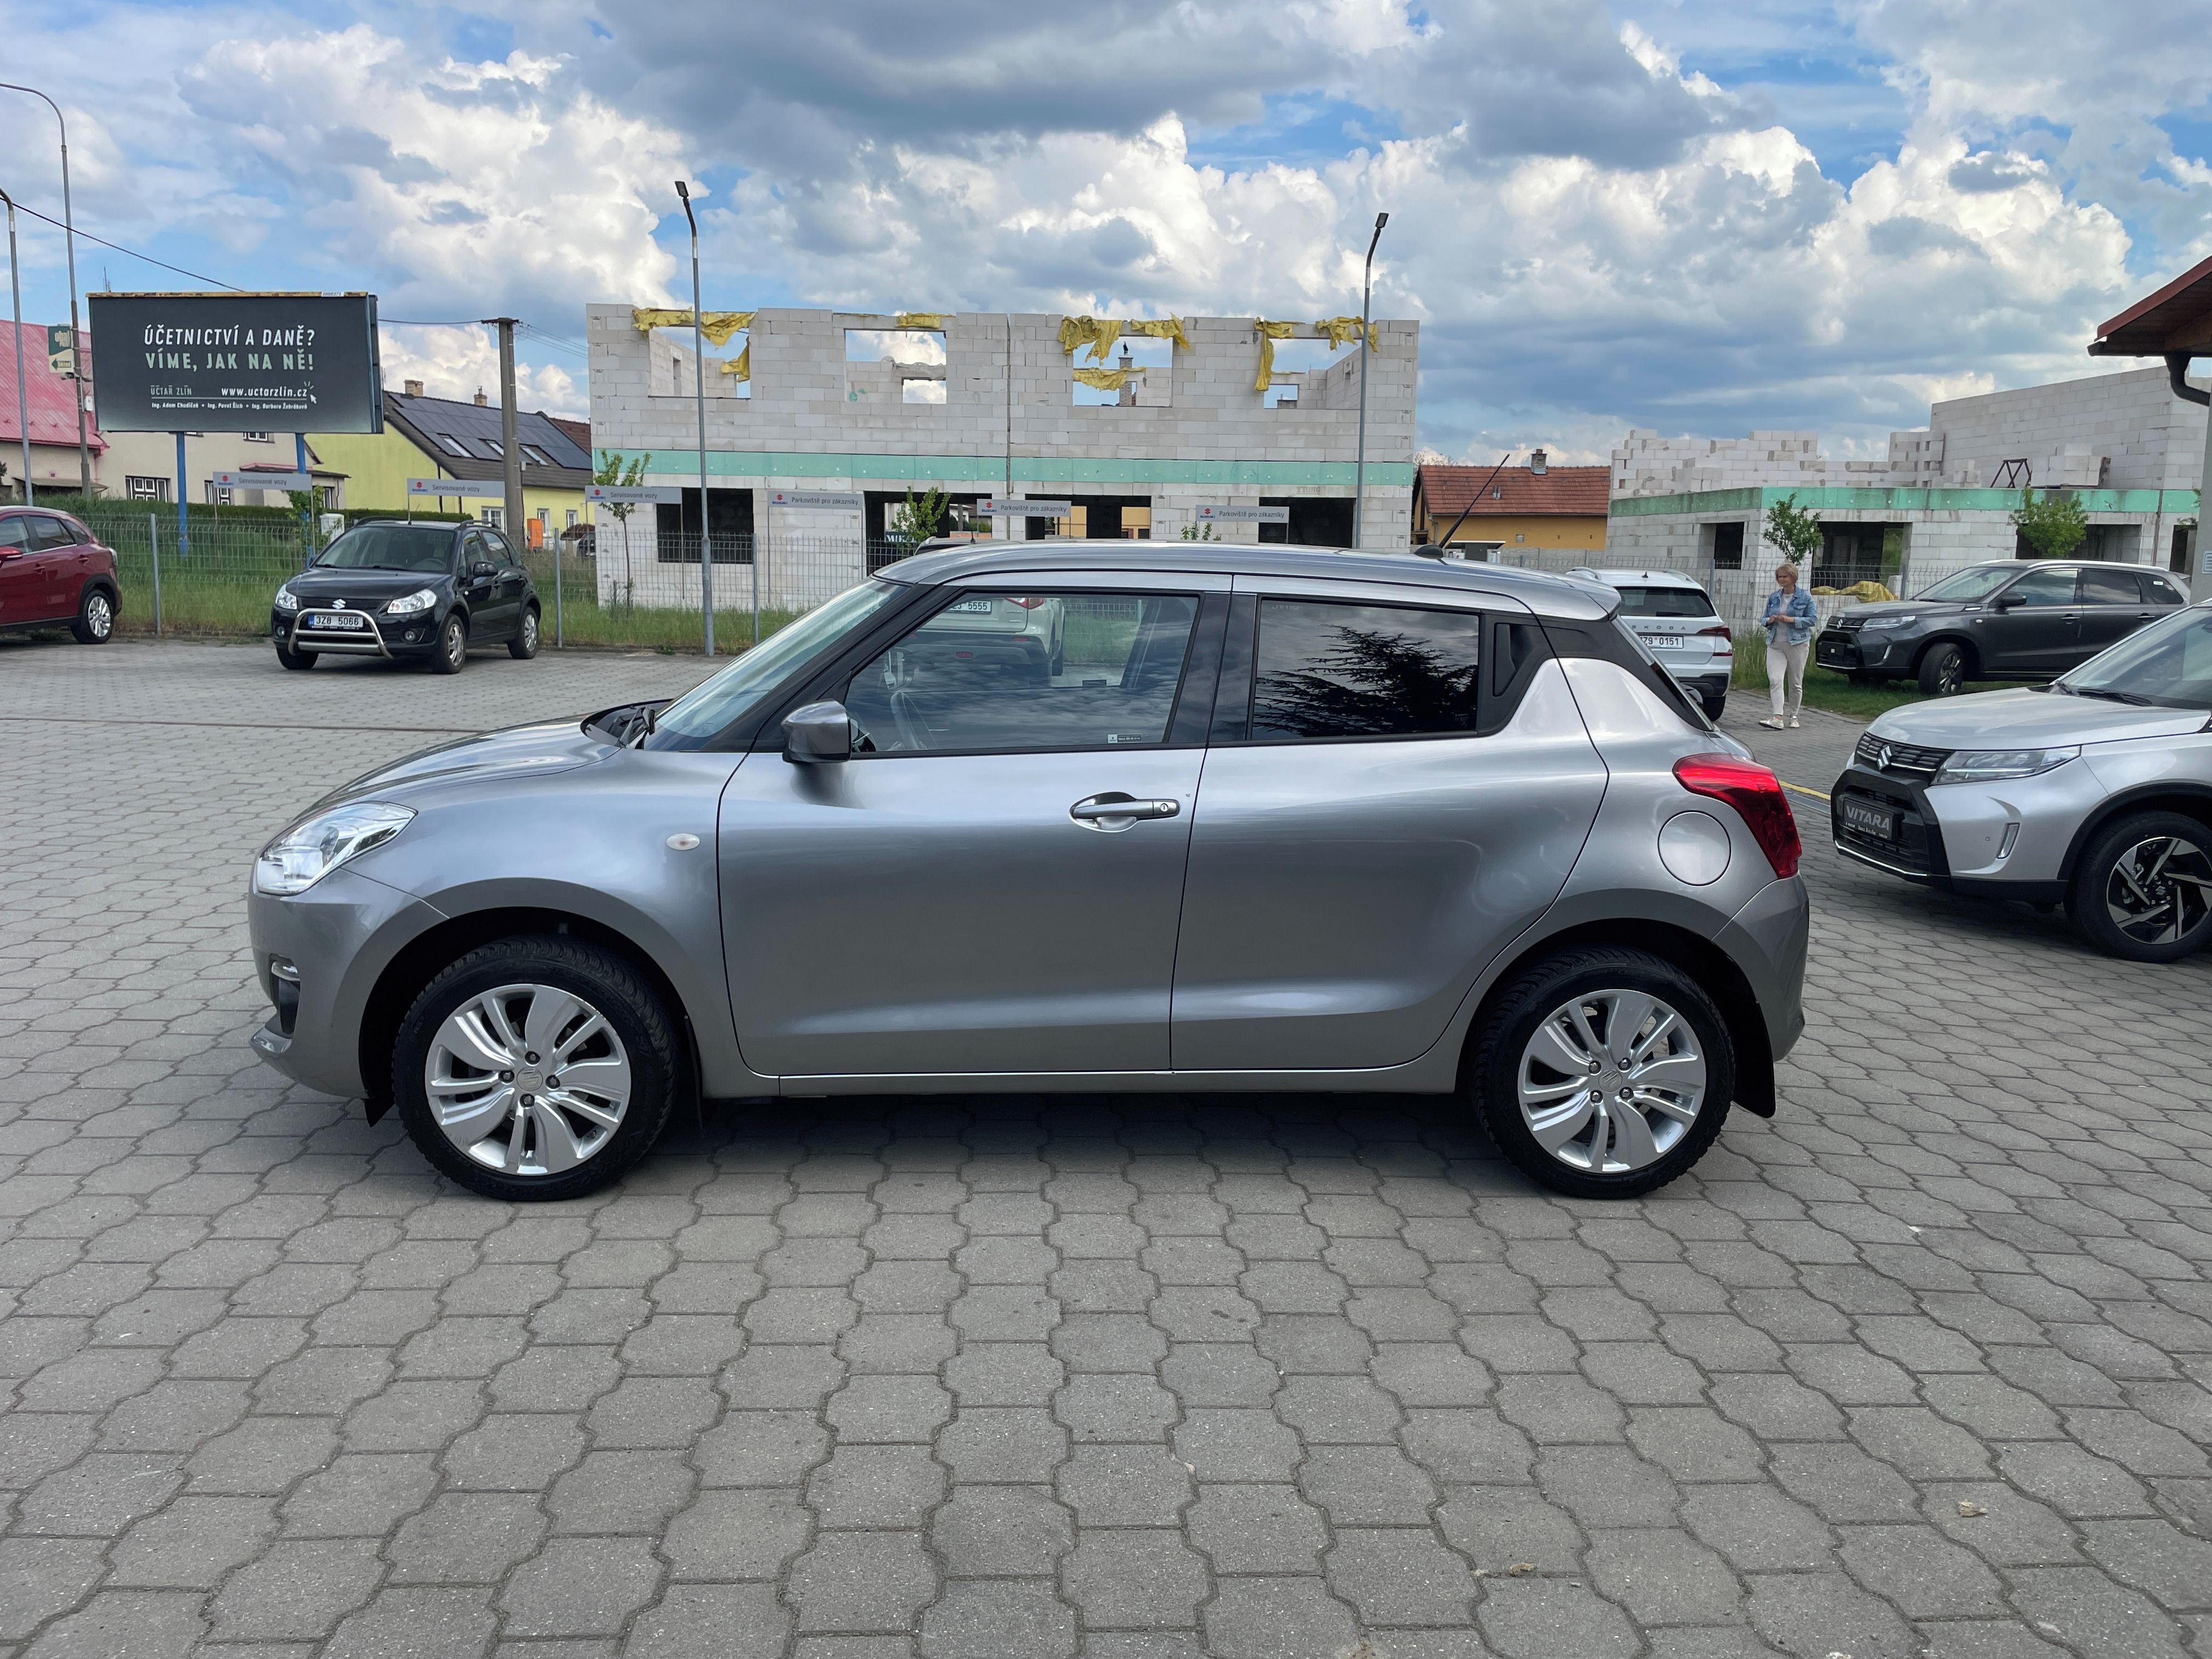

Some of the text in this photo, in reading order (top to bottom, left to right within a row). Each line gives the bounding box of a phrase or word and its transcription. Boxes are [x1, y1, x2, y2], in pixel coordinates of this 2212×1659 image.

[144, 324, 315, 346] ÚČETNICTVÍ A DANĚ?
[145, 348, 313, 372] VÍME, JAK NA NĚ!
[221, 386, 307, 397] www.uctarzlin.cz
[968, 602, 988, 611] 5555
[315, 616, 332, 625] 3Z8
[1659, 637, 1679, 646] 0151
[1846, 805, 1889, 831] VITARA
